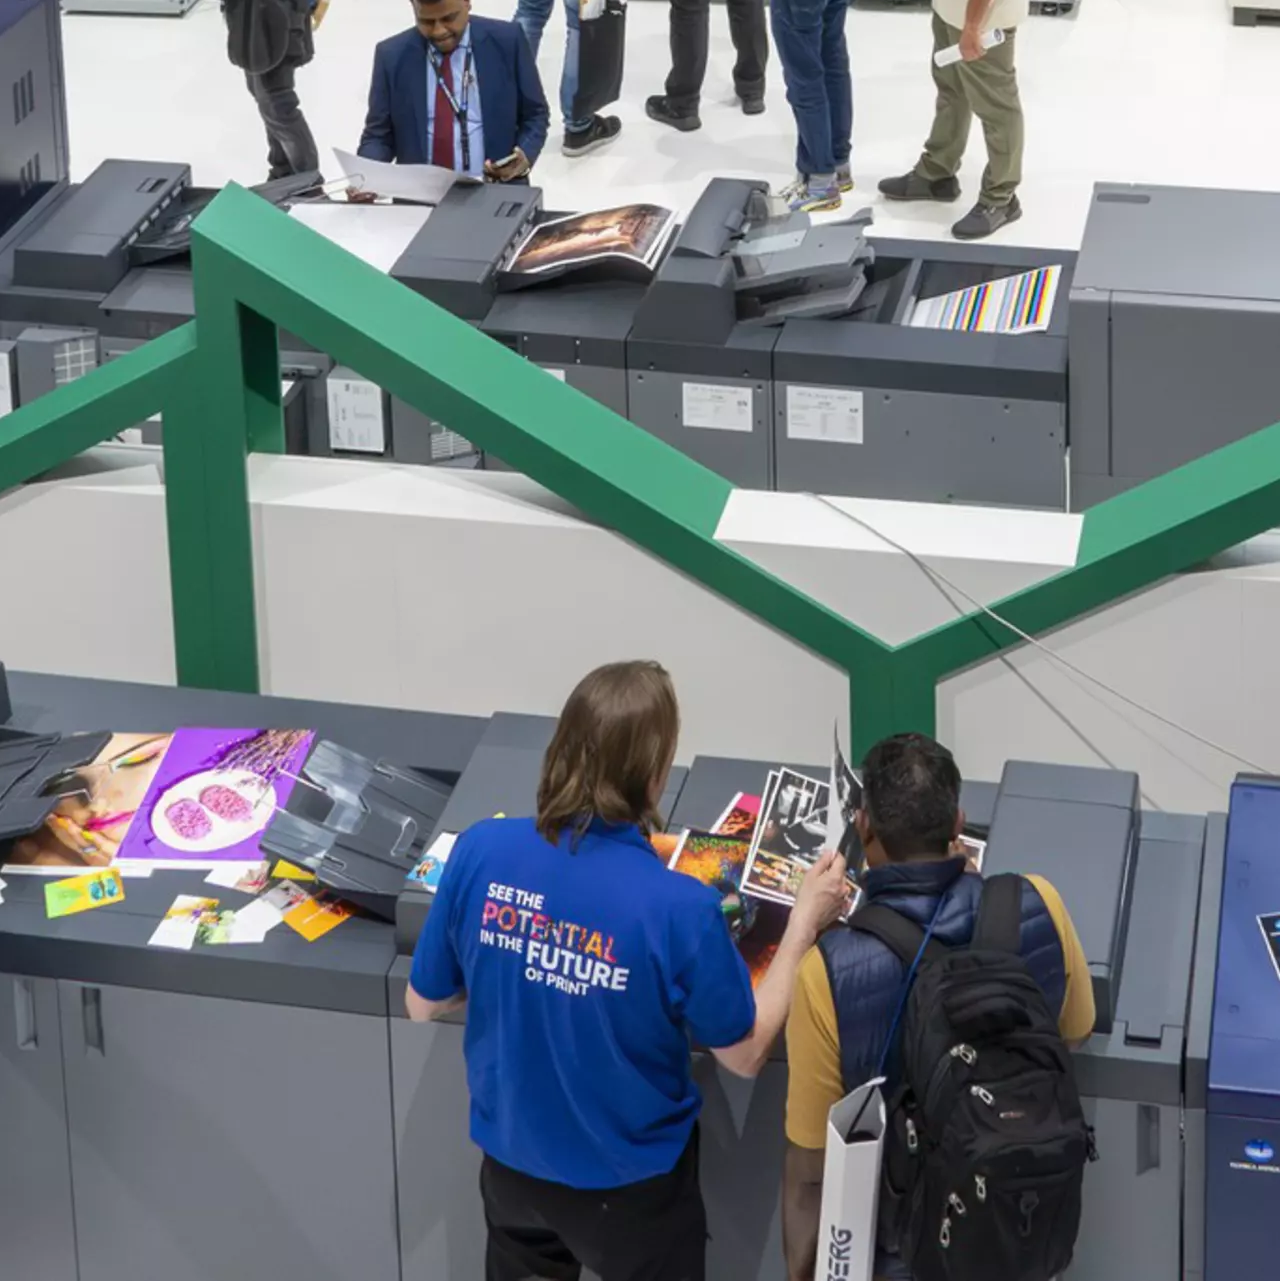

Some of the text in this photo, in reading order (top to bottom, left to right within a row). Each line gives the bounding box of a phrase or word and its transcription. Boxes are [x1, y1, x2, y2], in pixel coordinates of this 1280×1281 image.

[487, 881, 545, 911] SEE THE
[480, 928, 630, 991] IN THE FUTURE
[481, 900, 617, 964] POTENTIAL
[524, 967, 590, 996] OF PRINT
[826, 1223, 853, 1281] ERG
